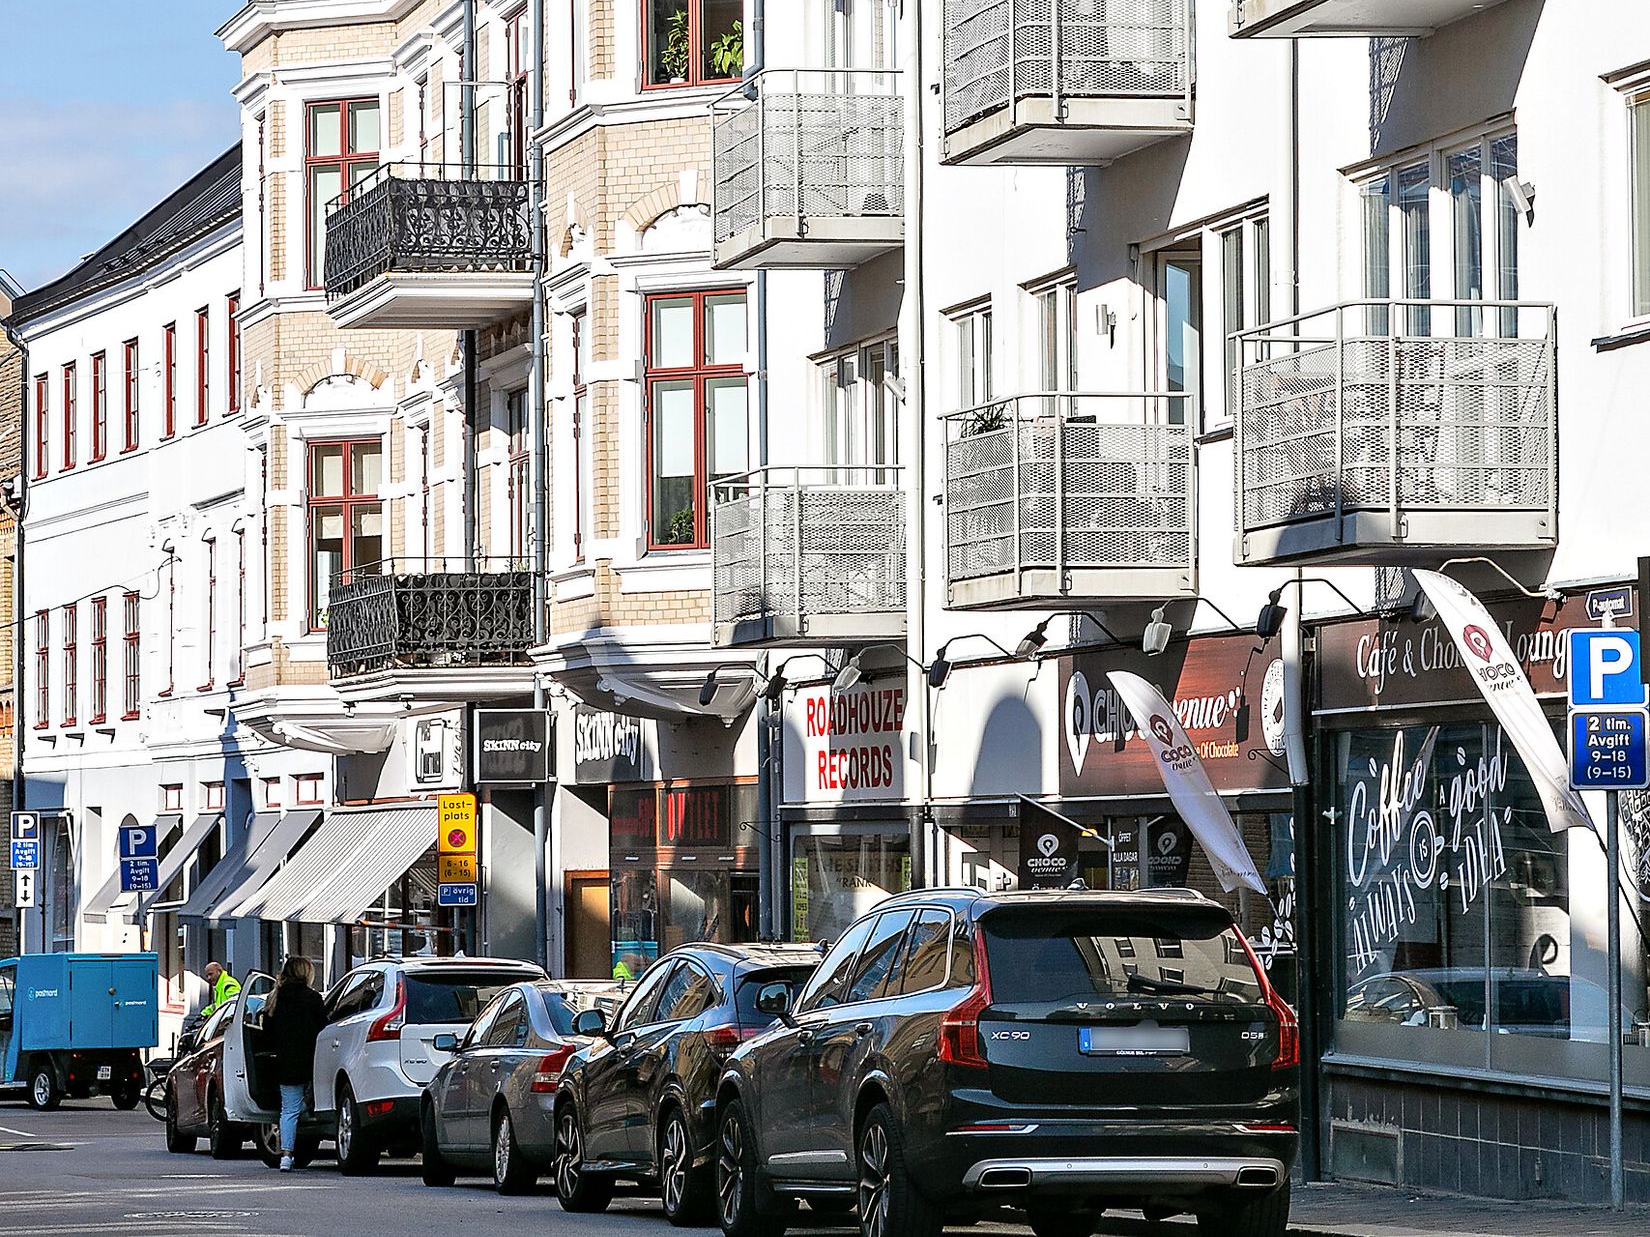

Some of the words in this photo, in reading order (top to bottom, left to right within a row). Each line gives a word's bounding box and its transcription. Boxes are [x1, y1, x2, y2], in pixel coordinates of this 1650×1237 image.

[1593, 596, 1625, 612] P-automat
[1356, 630, 1398, 694] Café
[1402, 638, 1416, 678] &
[1505, 620, 1570, 680] Loung
[1589, 636, 1634, 699] P
[806, 689, 903, 737] ROADHOUZE
[1588, 717, 1600, 731] 2
[1605, 717, 1632, 731] tim.
[483, 739, 520, 752] SKINN
[520, 741, 542, 752] city
[576, 711, 615, 765] SKINN
[614, 714, 639, 765] city
[1209, 740, 1239, 759] Chocolate
[1588, 733, 1630, 748] Avgift
[818, 745, 893, 790] RECORDS
[1587, 765, 1632, 780] (9-15)
[1450, 724, 1508, 853] good
[443, 800, 472, 809] Last-
[444, 811, 470, 821] plats
[667, 791, 719, 841] OUTLET
[1350, 730, 1428, 887] Coffee
[18, 814, 35, 838] P
[129, 829, 147, 855] P
[1418, 838, 1428, 862] IS
[130, 867, 150, 875] Avgift
[1027, 857, 1067, 867] CHOCO
[1457, 812, 1507, 915] IDEA
[452, 887, 474, 896] övrig
[1347, 863, 1416, 976] ALWAYS
[1077, 1002, 1194, 1011] VOLVO
